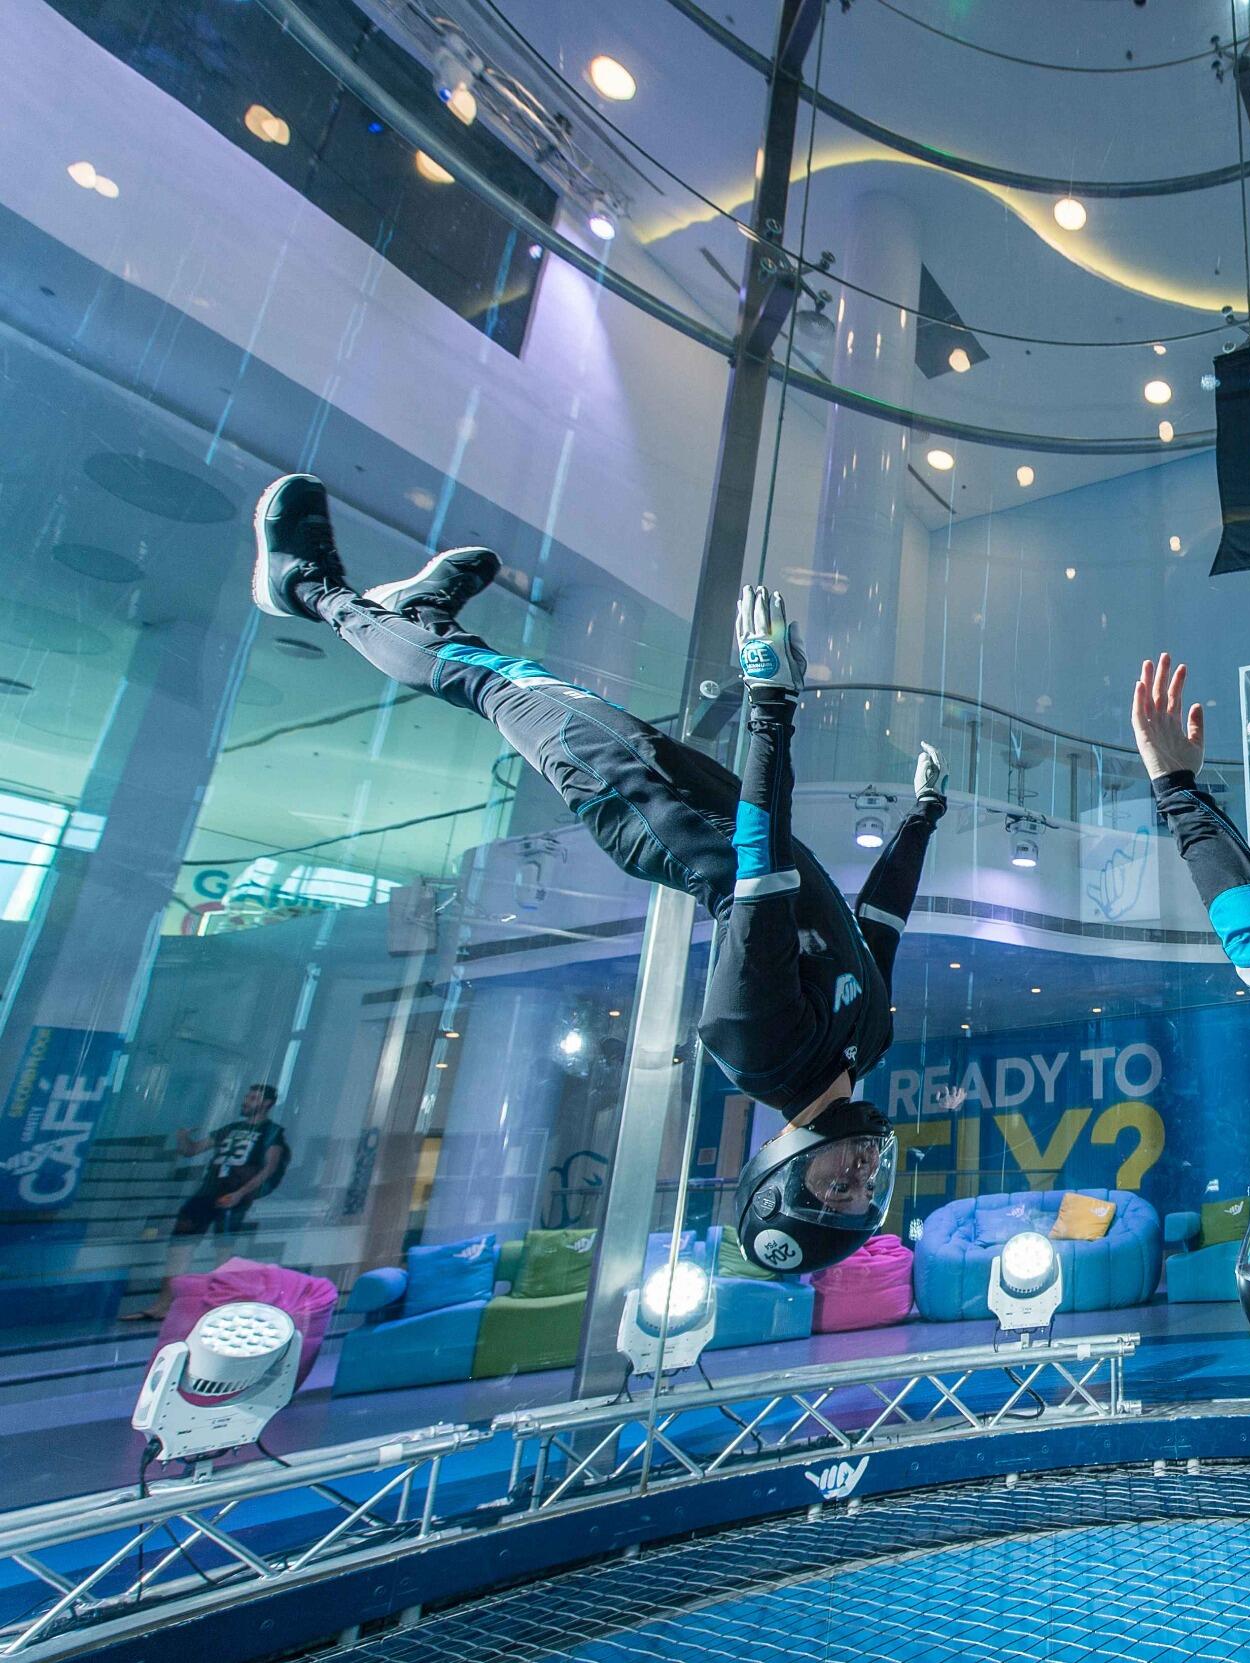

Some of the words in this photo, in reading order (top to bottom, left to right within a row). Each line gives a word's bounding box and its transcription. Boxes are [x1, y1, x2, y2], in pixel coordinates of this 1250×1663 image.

[743, 648, 771, 663] ICE
[888, 1052, 1069, 1118] READY
[1080, 1043, 1162, 1100] TO
[765, 1243, 796, 1265] 204
